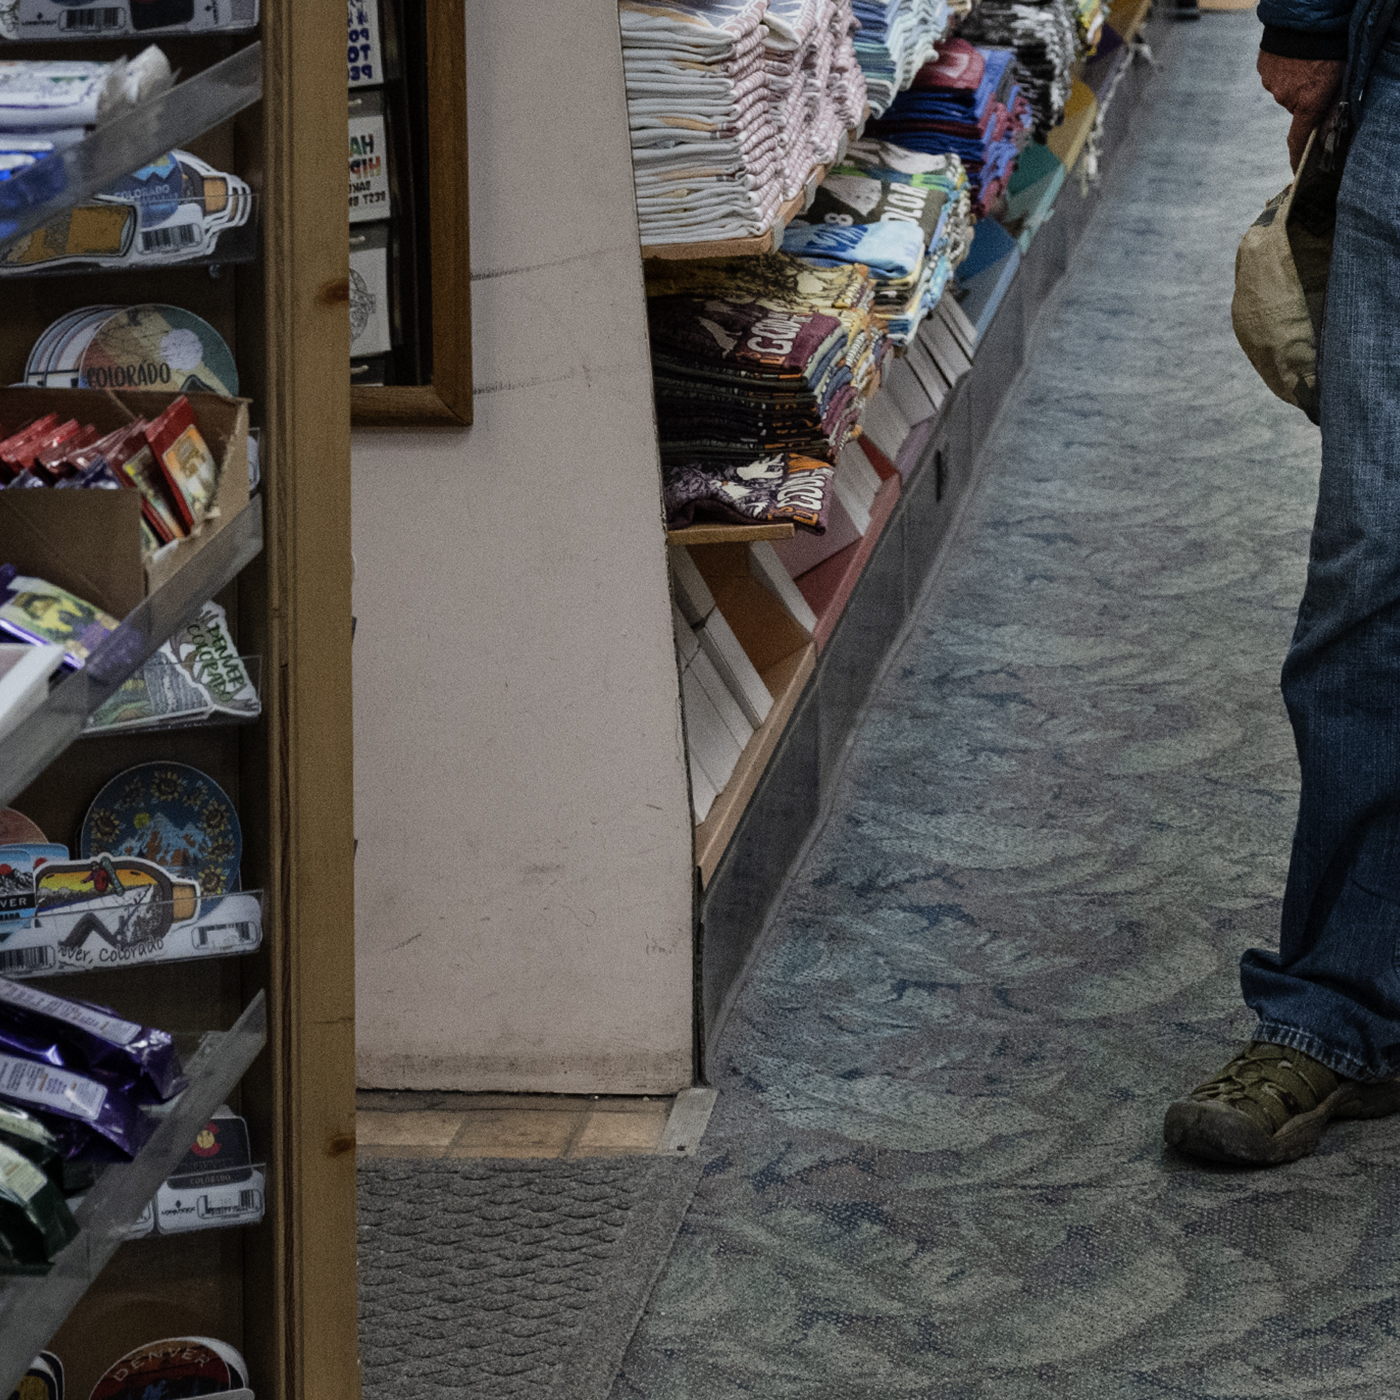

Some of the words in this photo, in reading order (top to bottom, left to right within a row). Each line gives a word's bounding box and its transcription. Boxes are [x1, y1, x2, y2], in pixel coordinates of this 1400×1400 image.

[87, 363, 171, 388] COLORADO
[206, 622, 248, 689] DENVER
[113, 1346, 211, 1383] DENVER
